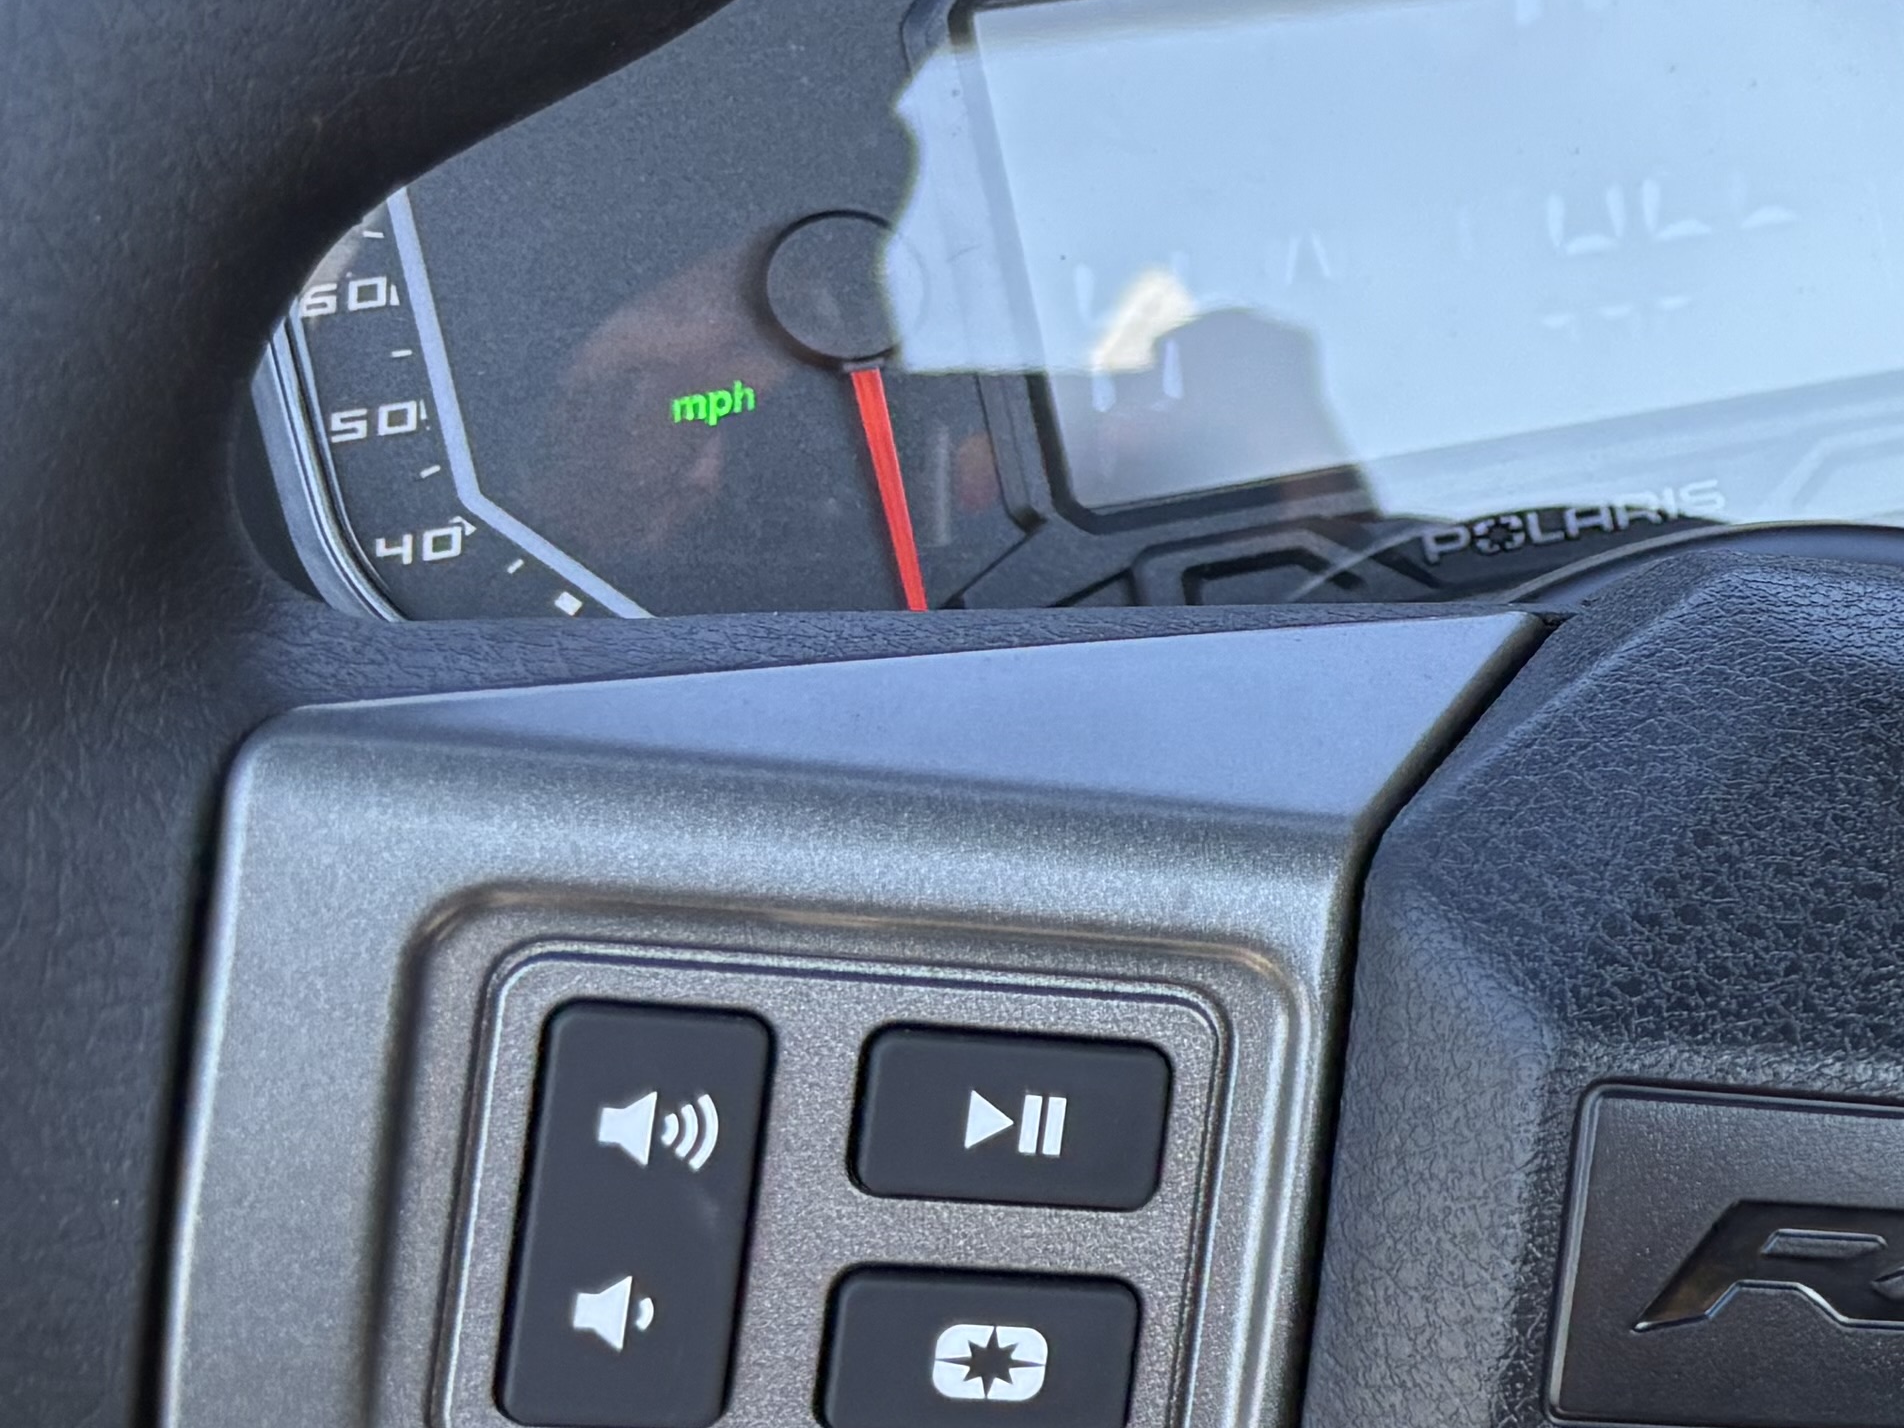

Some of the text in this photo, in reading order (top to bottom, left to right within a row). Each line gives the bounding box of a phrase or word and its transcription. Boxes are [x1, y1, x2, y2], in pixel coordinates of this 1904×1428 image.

[301, 277, 387, 318] 60
[331, 401, 416, 443] 50
[672, 379, 755, 426] mph
[1421, 479, 1725, 564] POLARIS
[375, 526, 462, 565] 40
